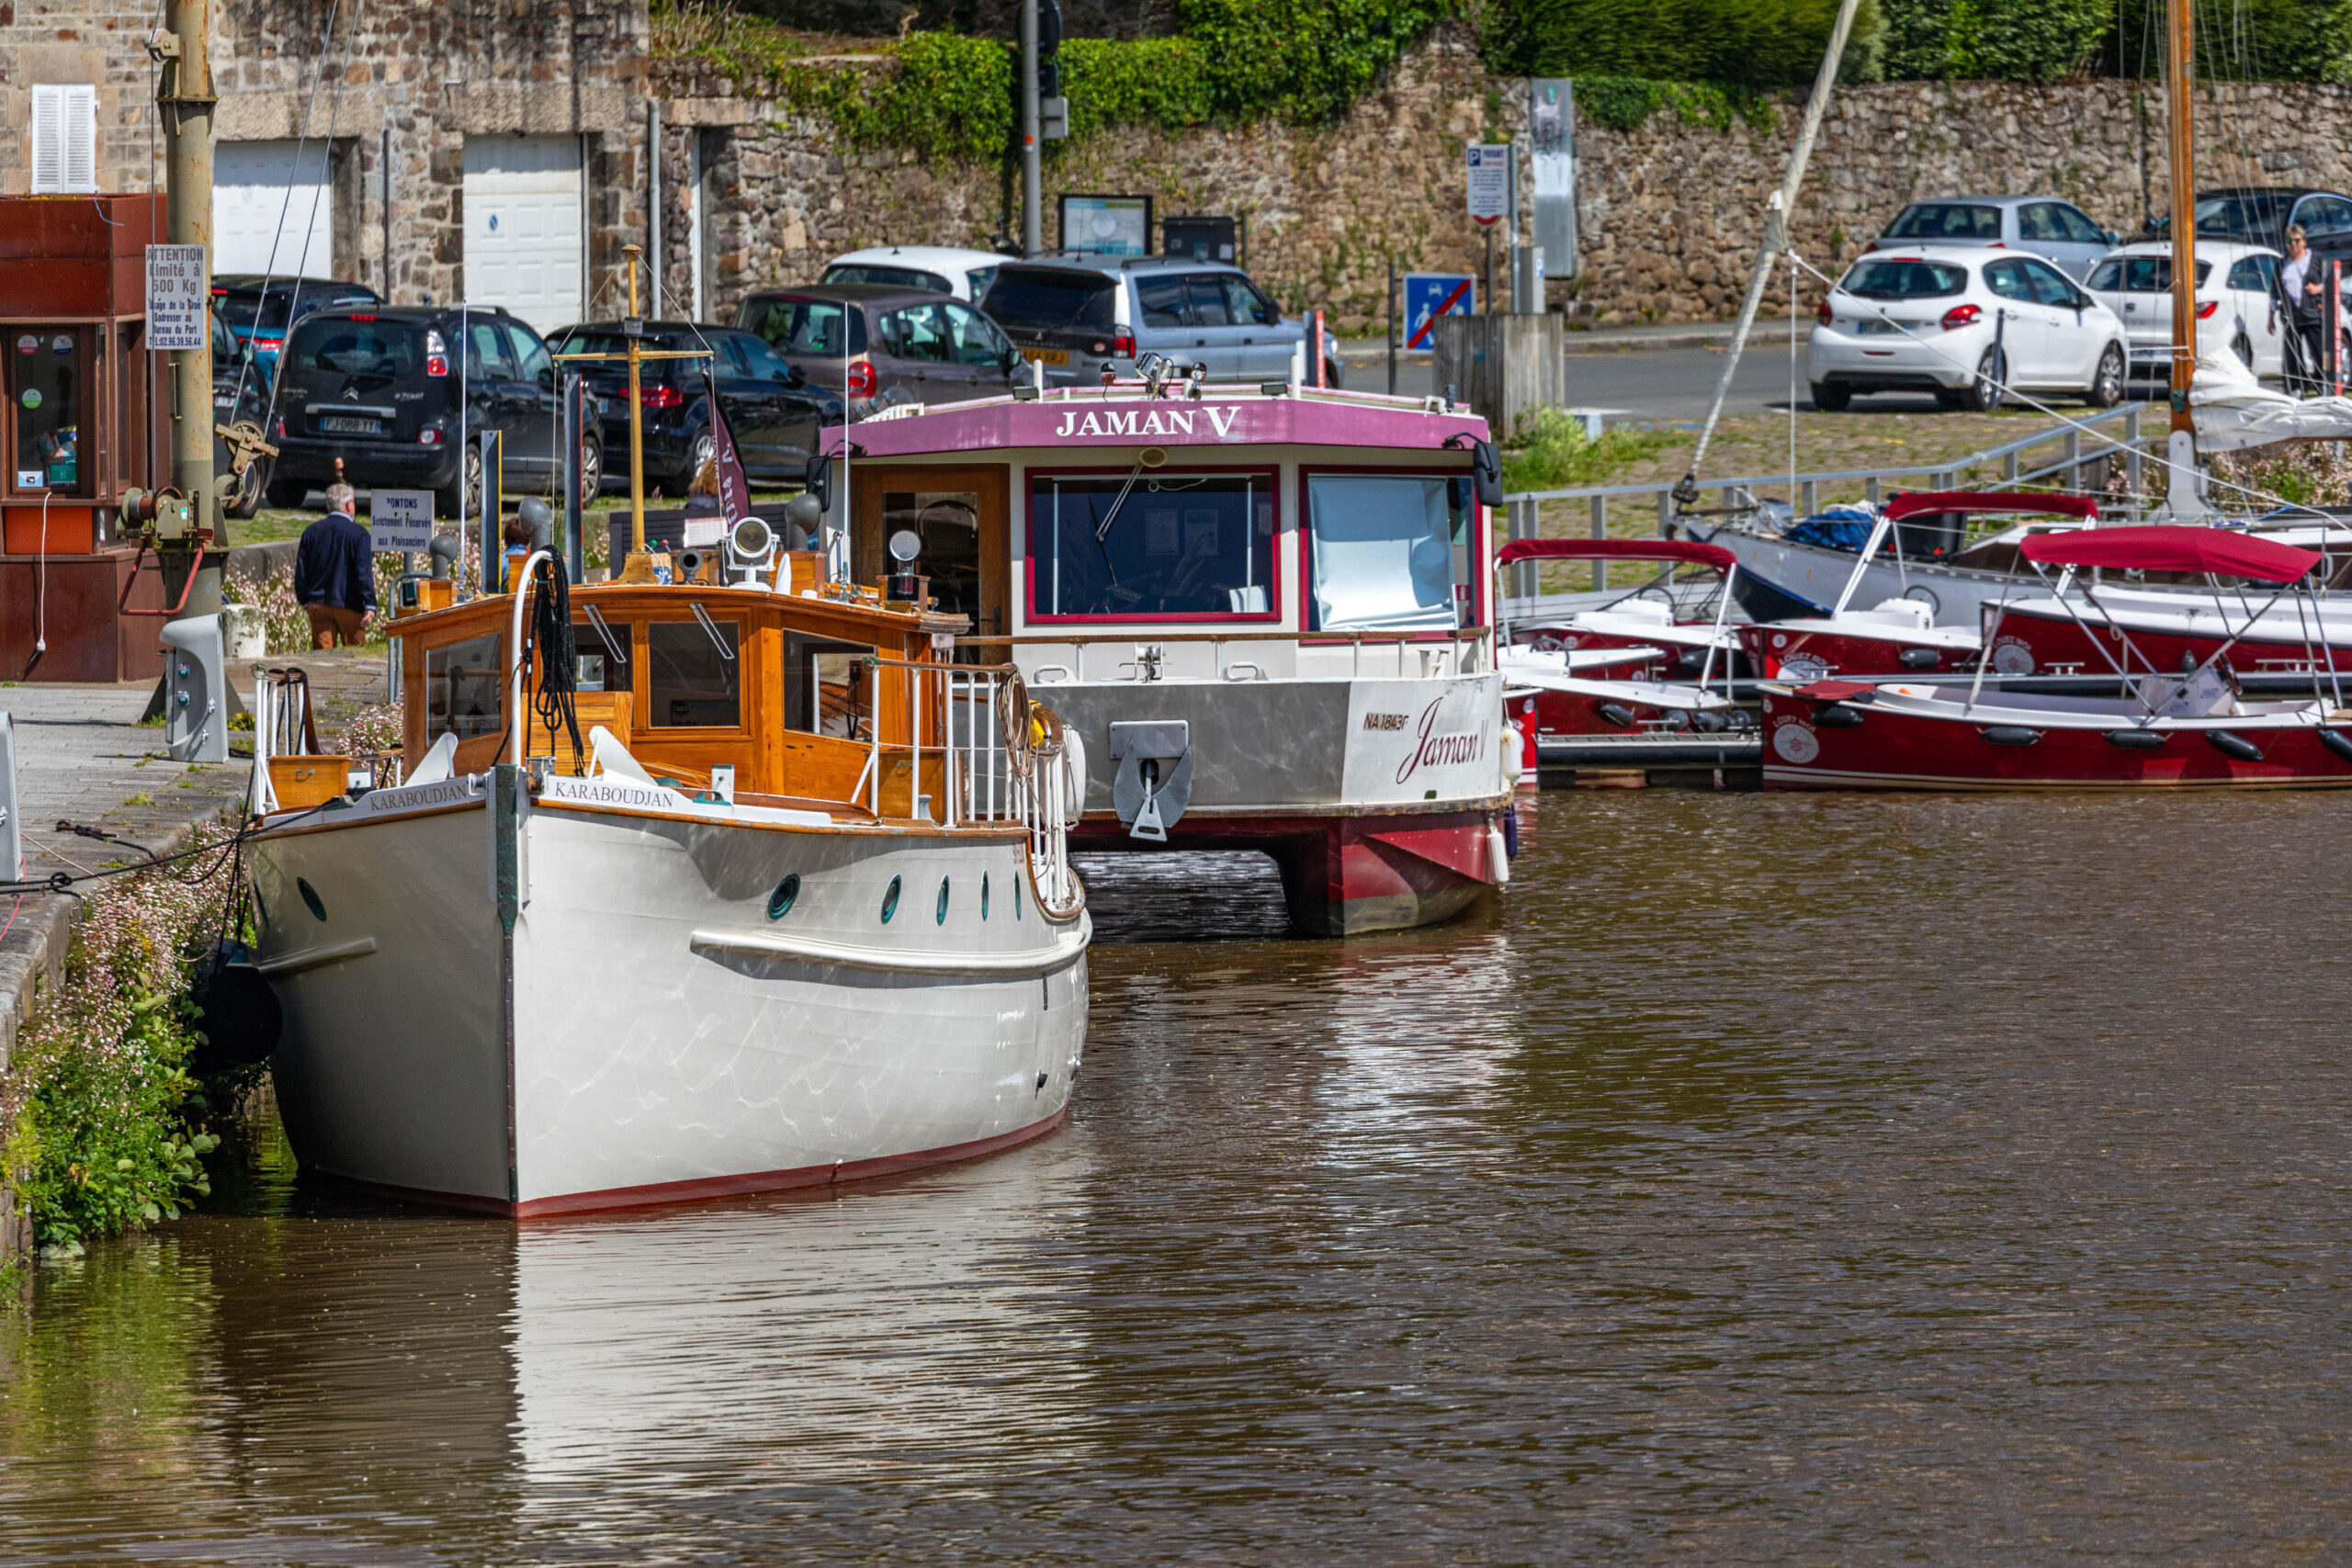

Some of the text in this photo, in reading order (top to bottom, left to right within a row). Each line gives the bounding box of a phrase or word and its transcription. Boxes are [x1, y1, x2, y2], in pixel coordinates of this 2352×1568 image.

[147, 248, 203, 261] ATTENTION
[193, 263, 200, 276] à
[153, 279, 197, 295] 500 Kg
[169, 299, 176, 310] de
[179, 299, 186, 310] la
[175, 324, 183, 334] du
[185, 324, 198, 334] Port
[1057, 406, 1241, 437] JAMAN V
[386, 498, 418, 509] PONTONS
[378, 536, 426, 547] aux Plaisanciers
[1778, 651, 1811, 666] LOUEZ
[1363, 713, 1378, 729] NA
[1396, 696, 1489, 784] Jaman V
[370, 784, 468, 811] KARABOUDJAN
[555, 782, 674, 807] KARABOUDJAN
